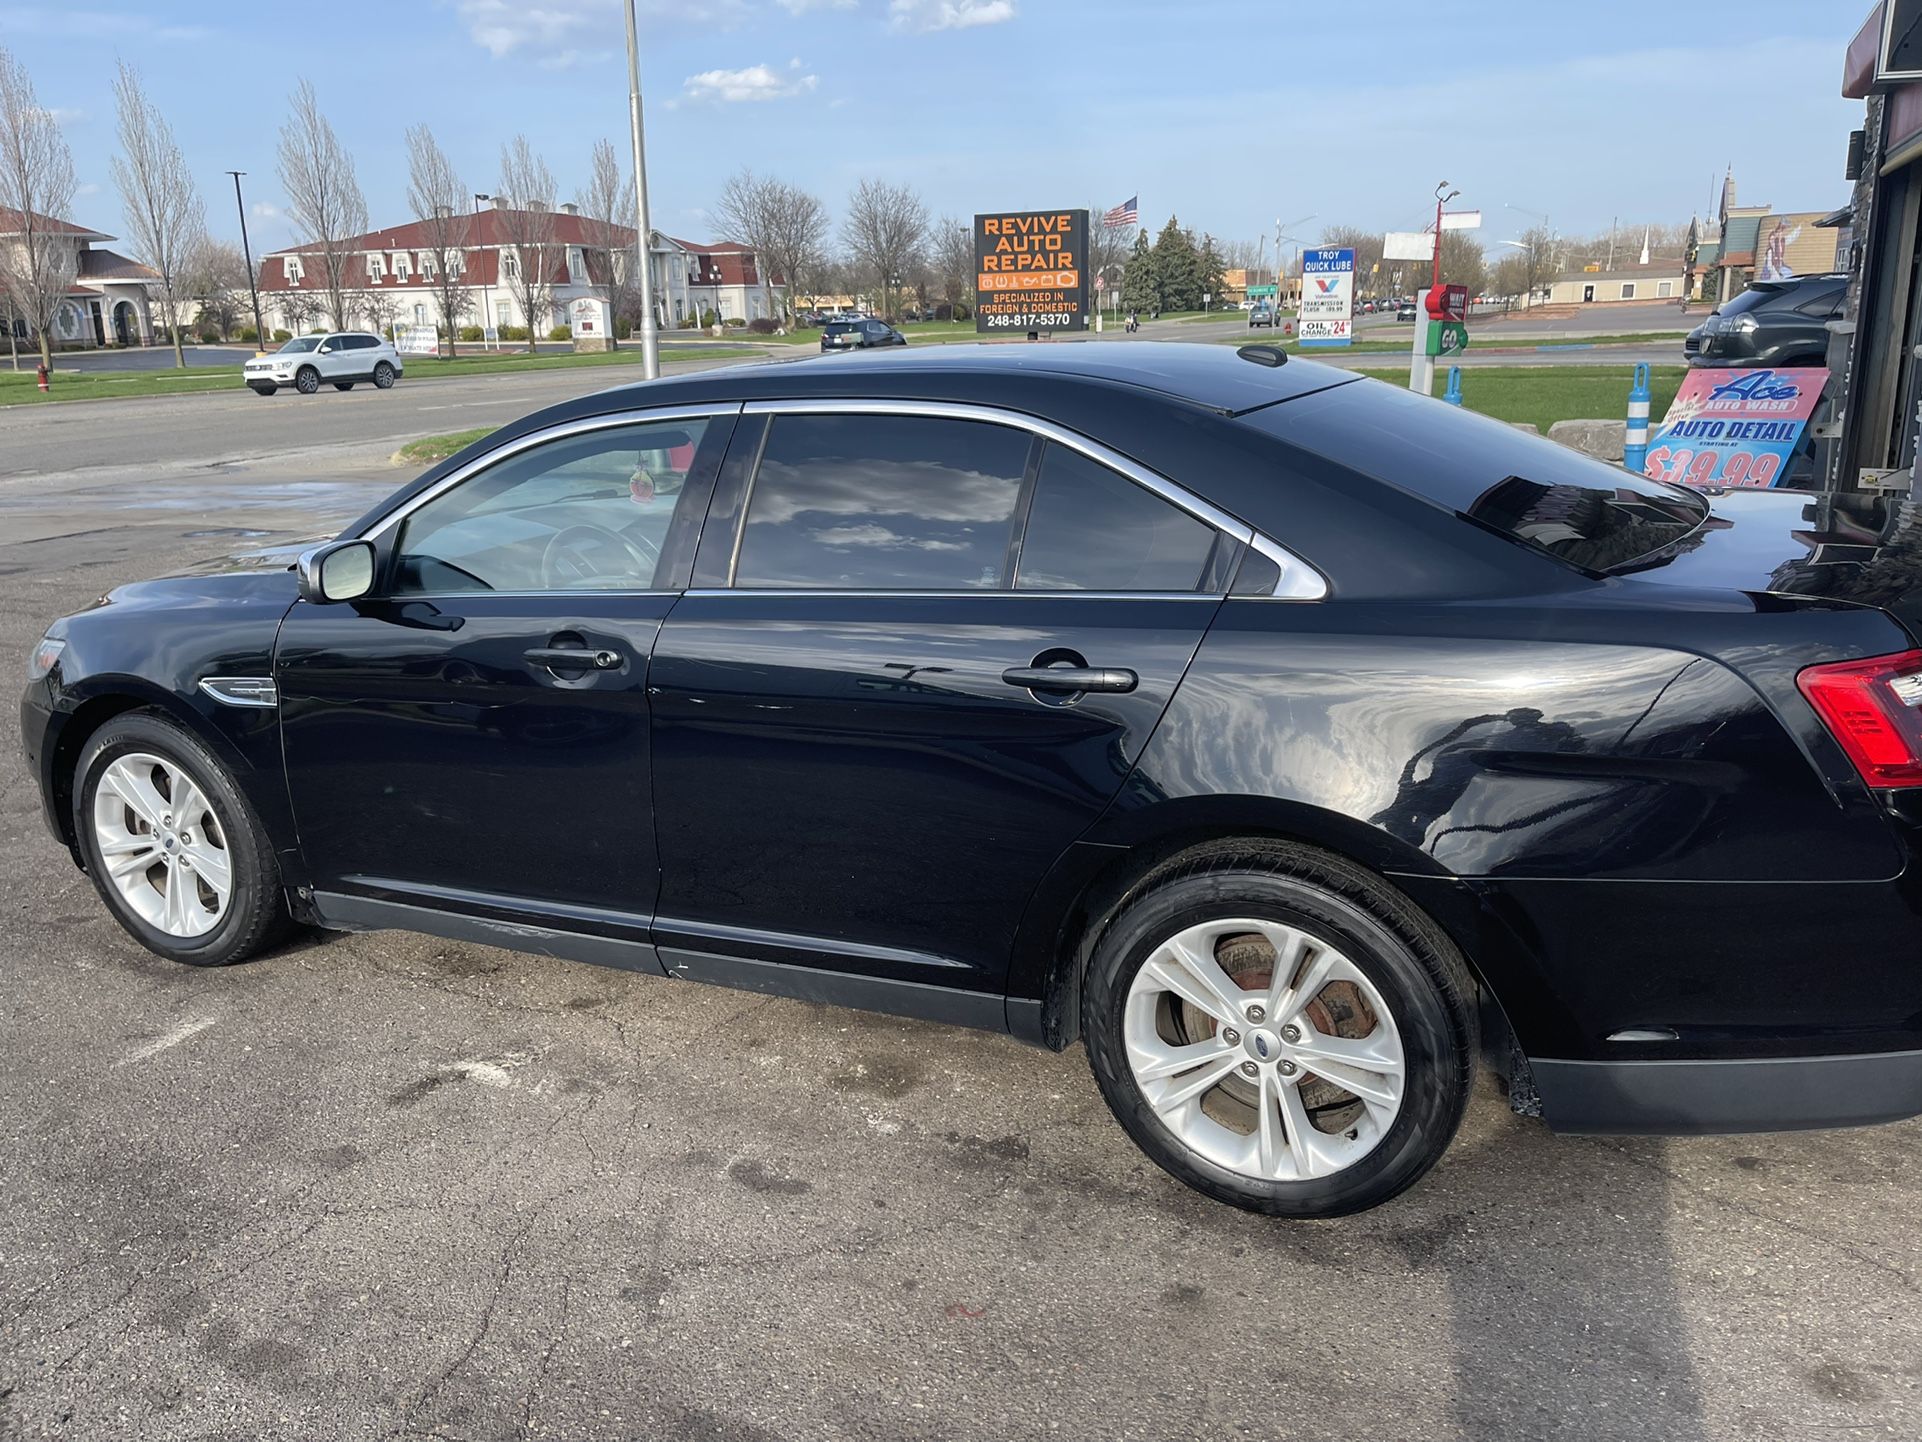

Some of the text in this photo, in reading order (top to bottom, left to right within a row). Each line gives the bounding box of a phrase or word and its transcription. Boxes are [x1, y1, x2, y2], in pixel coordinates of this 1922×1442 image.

[985, 215, 1071, 235] REVIVE
[995, 234, 1061, 252] AUTO
[984, 252, 1073, 271] REPAIR
[1318, 251, 1340, 260] TROY
[1305, 261, 1351, 271] QUICK LUBE
[994, 292, 1063, 302] SPECIALIZED IN
[980, 303, 1077, 313] FOREIGN & DOMESTIC
[988, 313, 1070, 326] 248-817-5370
[1307, 322, 1325, 330] OIL
[1442, 330, 1457, 348] GO
[1708, 370, 1799, 401] Ace
[1706, 400, 1740, 411] AUTO
[1745, 400, 1789, 411] WASH
[1669, 421, 1796, 441] AUTO DETAIL
